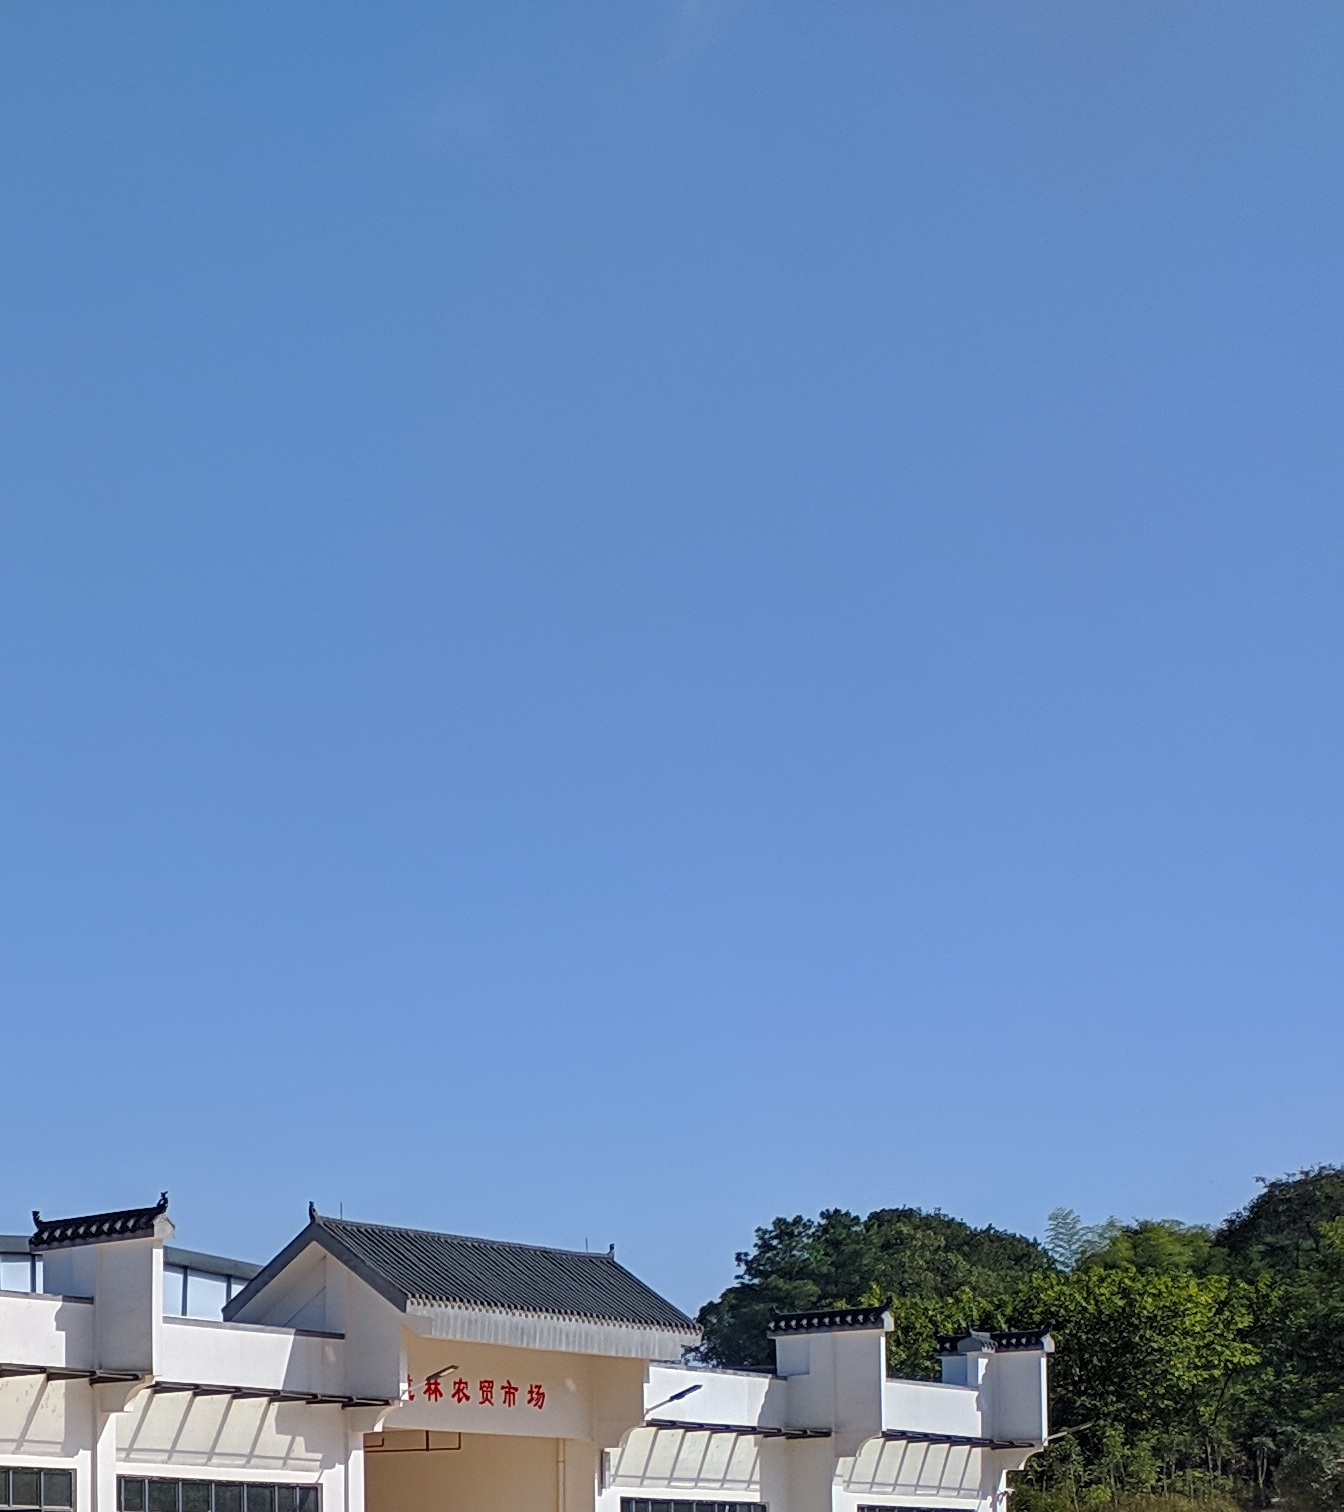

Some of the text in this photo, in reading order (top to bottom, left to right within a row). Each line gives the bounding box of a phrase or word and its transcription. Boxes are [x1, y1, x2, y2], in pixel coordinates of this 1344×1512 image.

[407, 1374, 547, 1410] 林农贸市场
